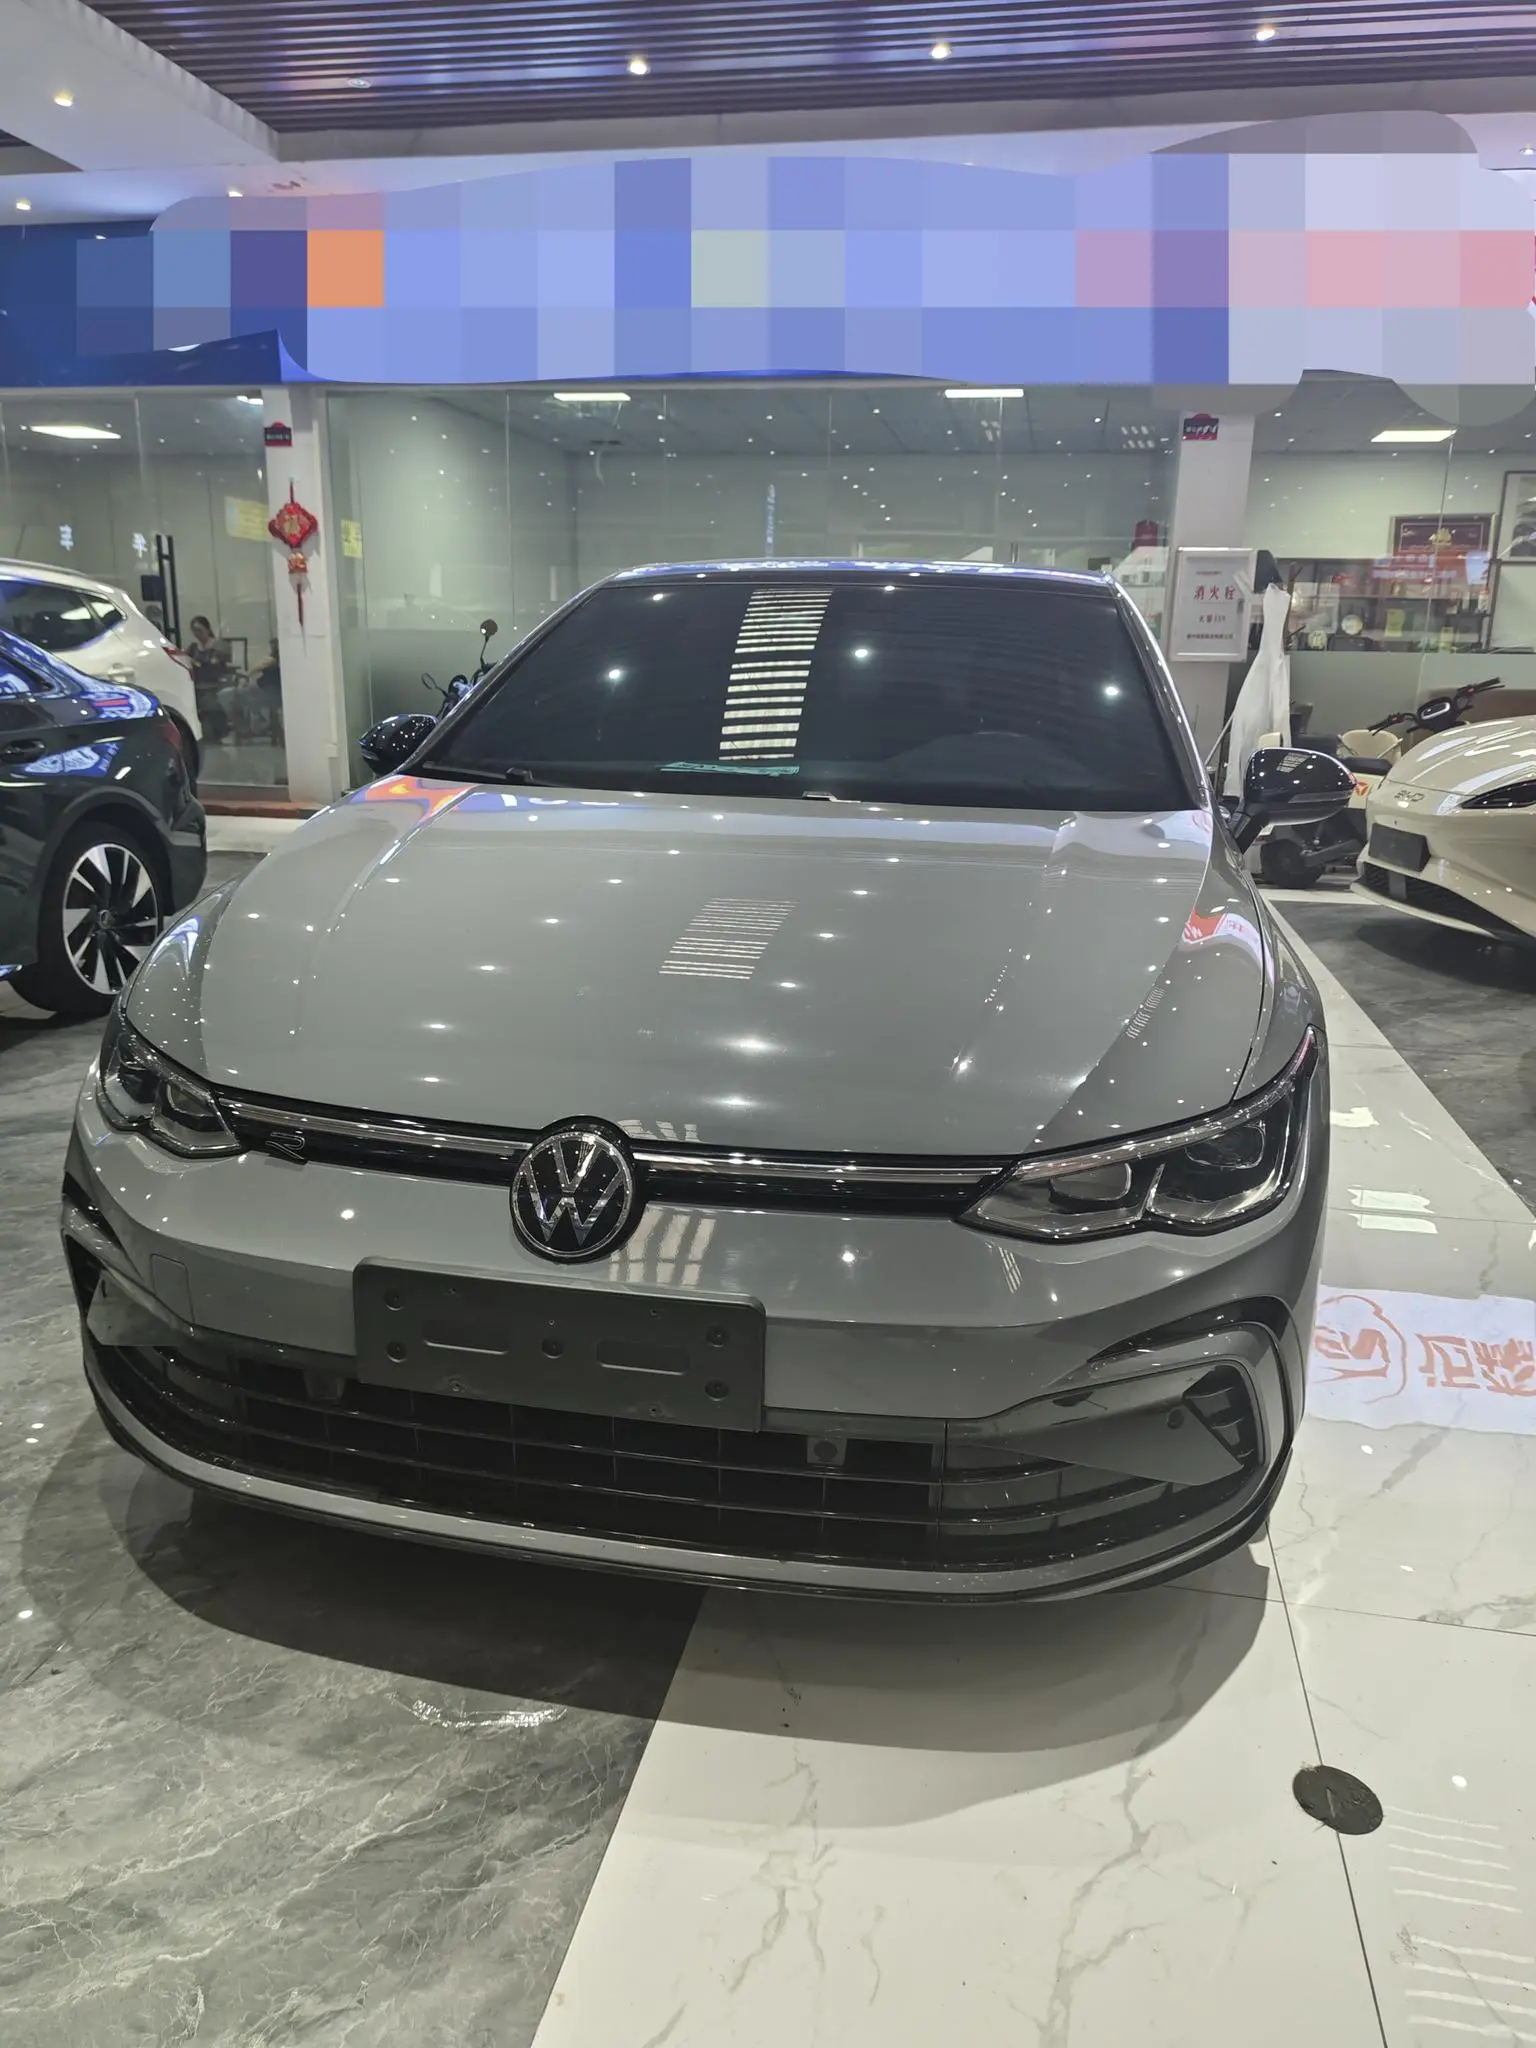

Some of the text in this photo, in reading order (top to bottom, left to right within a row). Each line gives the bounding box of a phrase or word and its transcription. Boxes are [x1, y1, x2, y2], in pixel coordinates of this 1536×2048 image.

[1194, 585, 1236, 601] 消火栓
[1394, 789, 1426, 803] BYD
